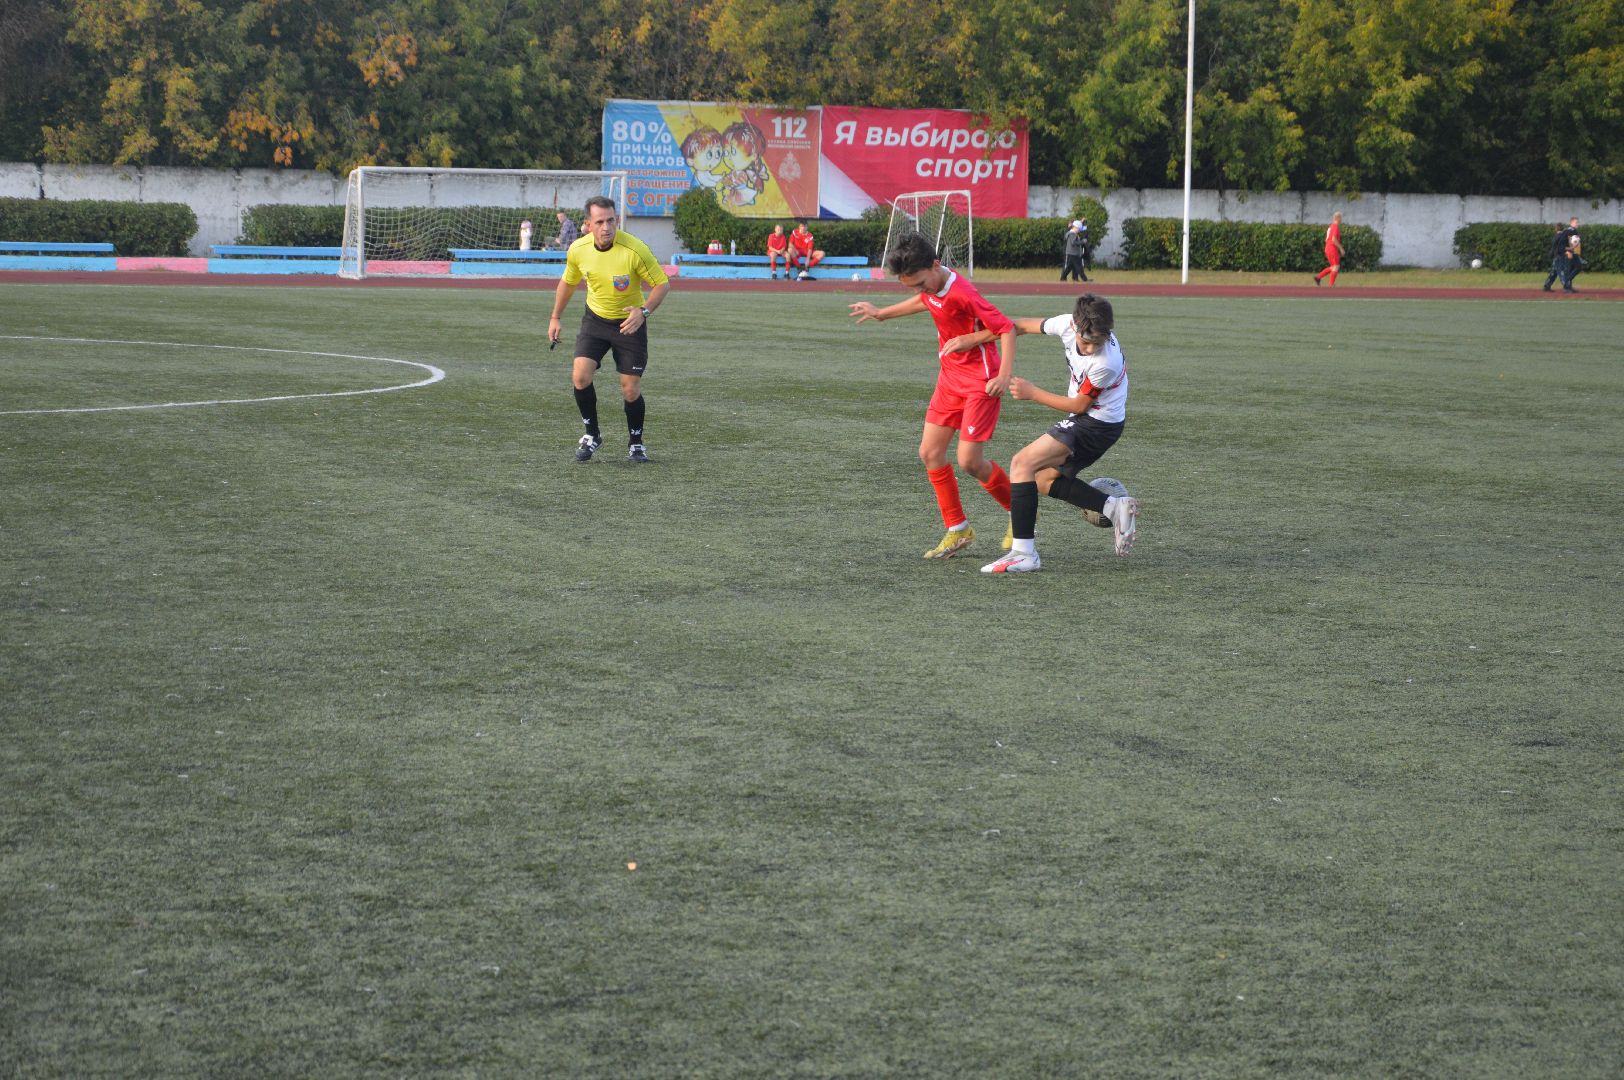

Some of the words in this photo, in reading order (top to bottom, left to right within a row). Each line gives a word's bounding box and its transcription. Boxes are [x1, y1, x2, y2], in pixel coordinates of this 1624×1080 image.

[612, 120, 672, 144] 80%
[771, 116, 807, 138] 112
[833, 120, 857, 145] Я
[865, 121, 1017, 154] выбираю
[611, 143, 672, 155] ПРИЧИН
[611, 154, 685, 167] ПОЖАРОВ
[916, 154, 1018, 184] спорт!
[626, 179, 691, 189] БРАЩЕНИЕ
[627, 191, 639, 206] С
